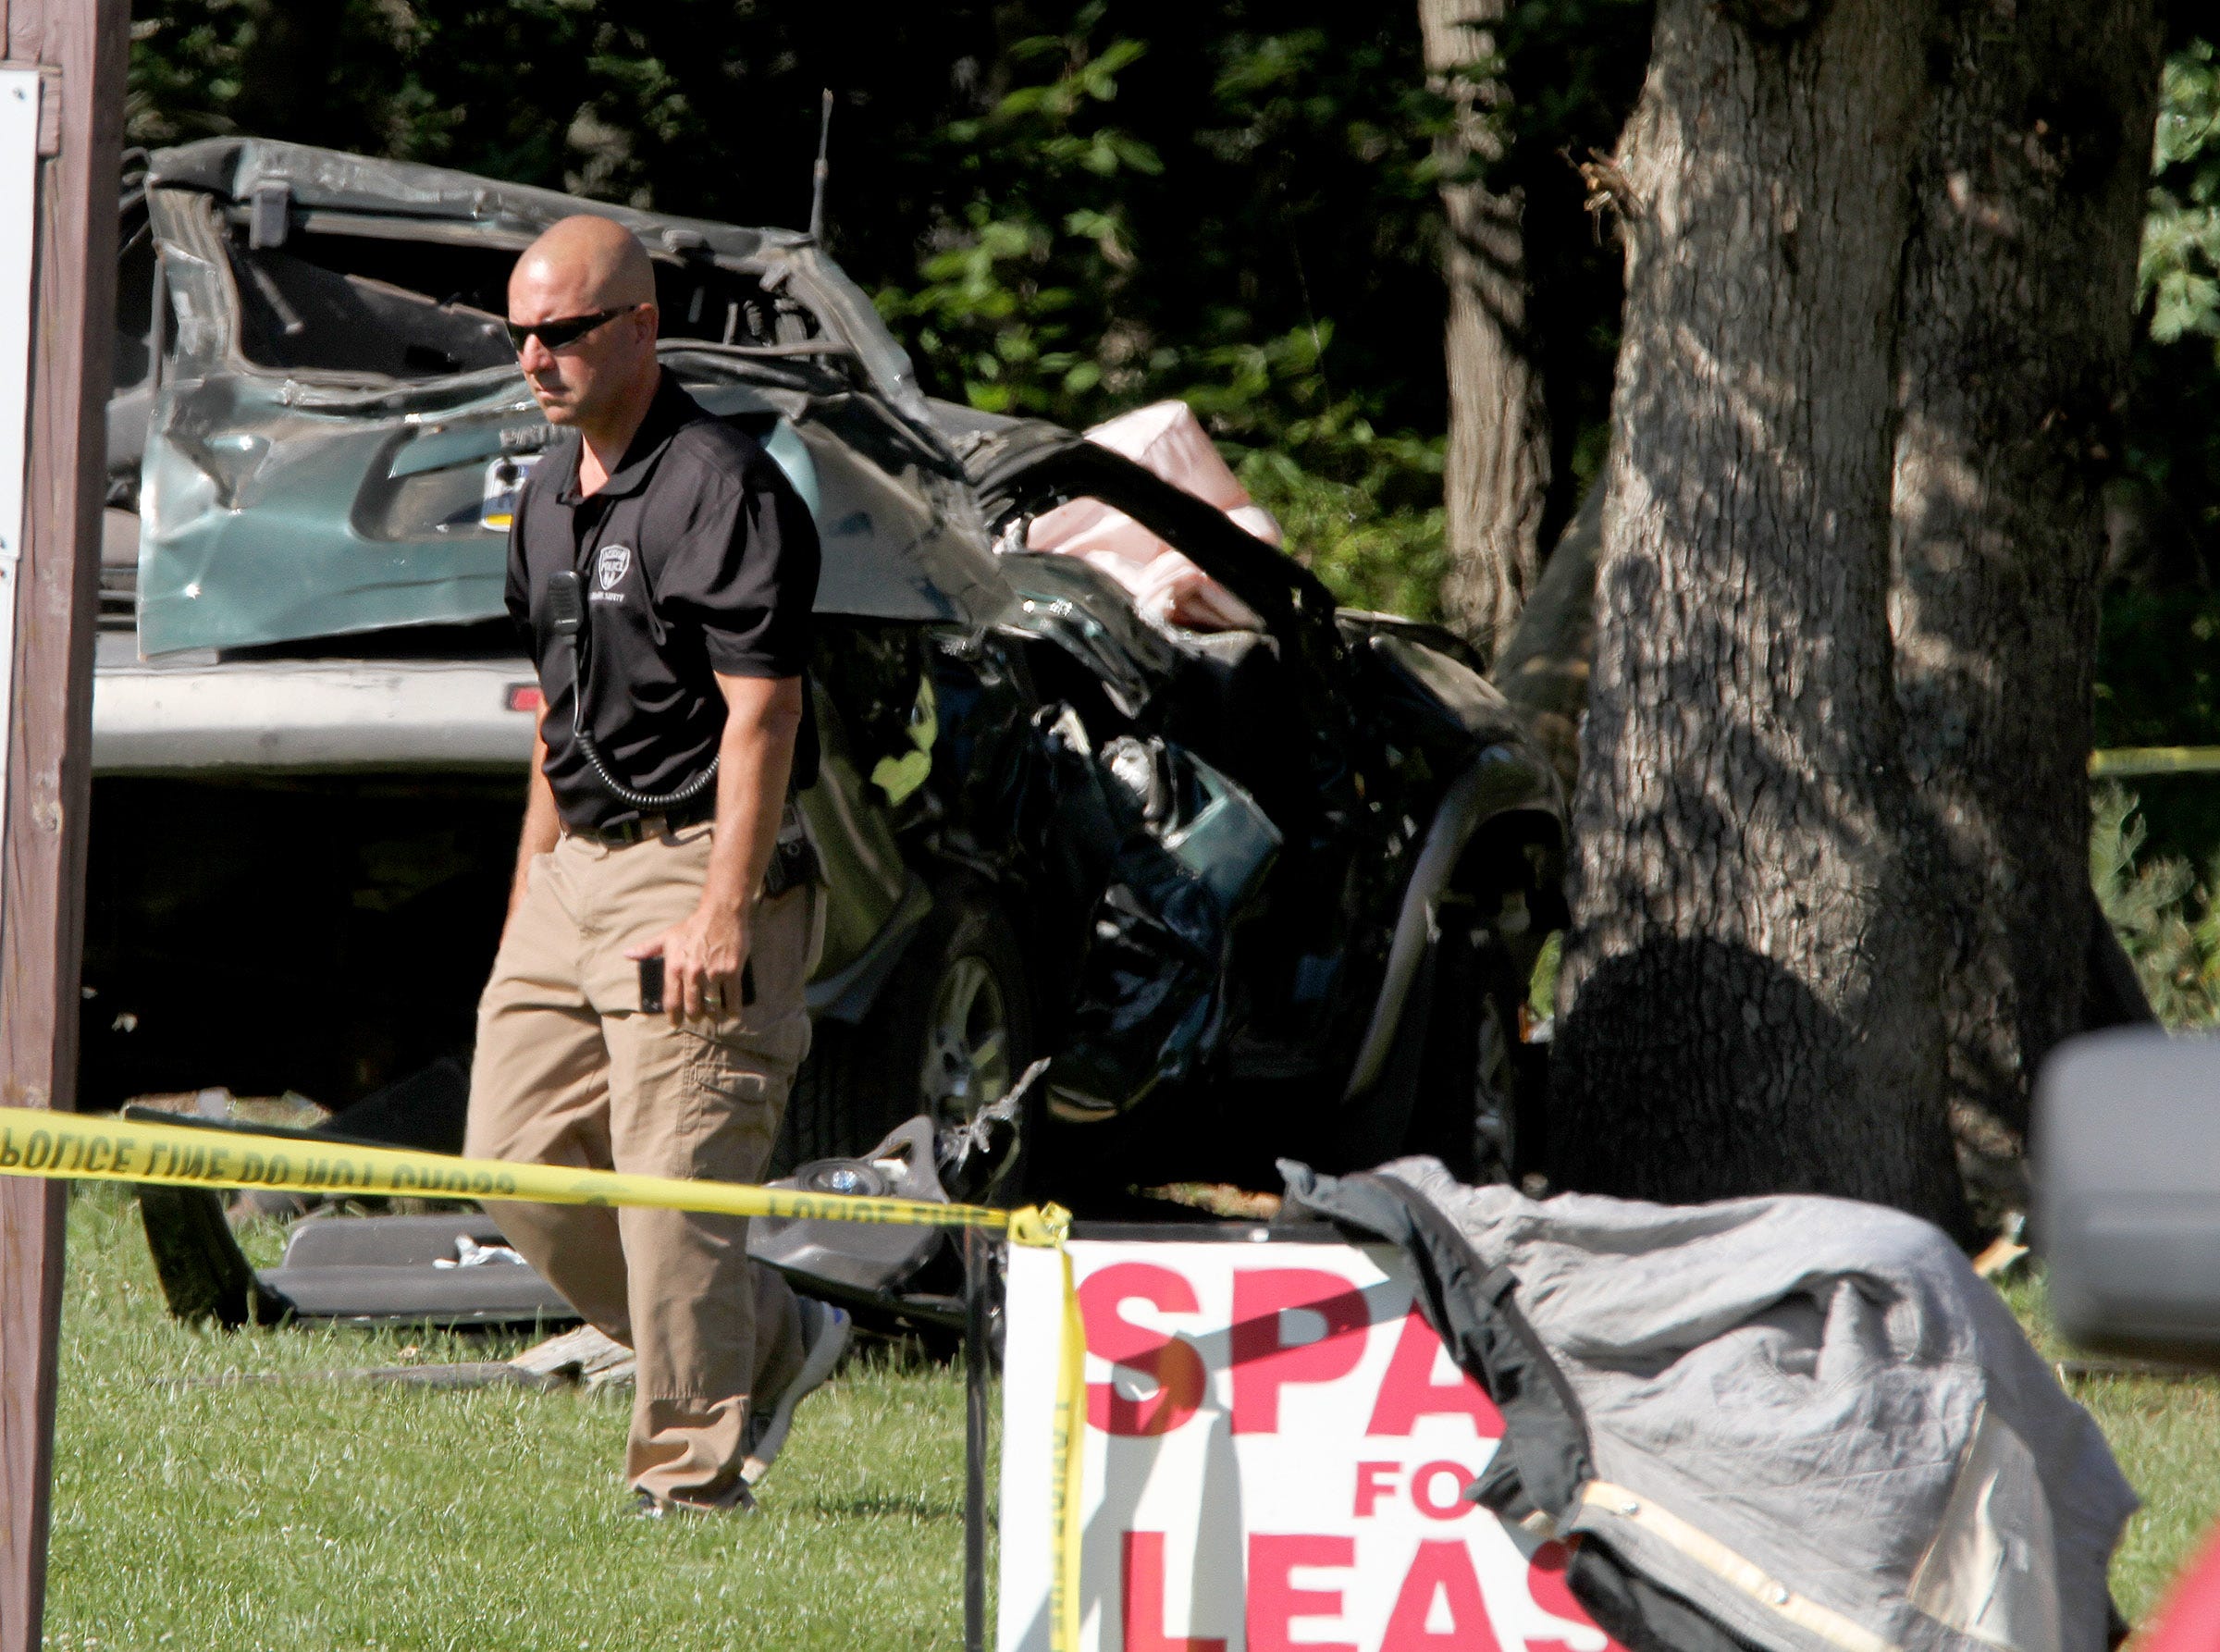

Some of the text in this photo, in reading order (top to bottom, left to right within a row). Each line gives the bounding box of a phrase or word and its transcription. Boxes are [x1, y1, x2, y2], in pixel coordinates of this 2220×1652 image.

[1074, 1261, 1508, 1439] SPA
[1352, 1460, 1480, 1520] FO
[1121, 1530, 1621, 1652] LEAS
